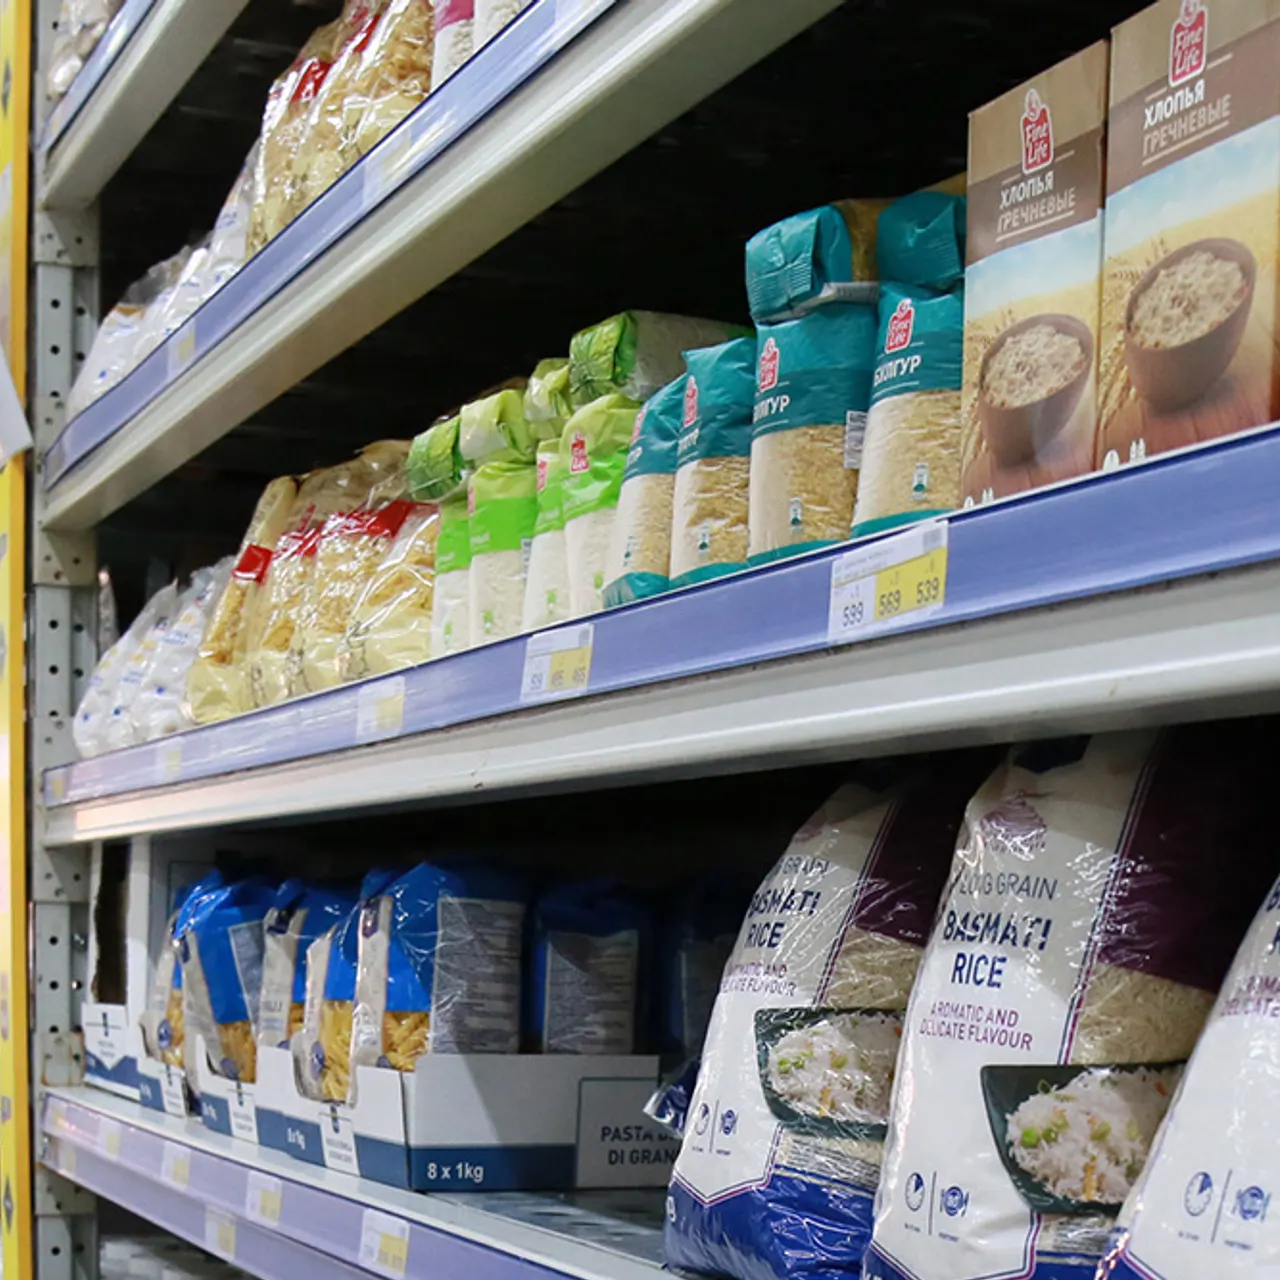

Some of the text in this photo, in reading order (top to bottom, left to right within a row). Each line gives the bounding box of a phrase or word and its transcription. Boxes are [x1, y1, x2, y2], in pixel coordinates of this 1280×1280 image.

[1176, 26, 1203, 51] Fine
[1174, 48, 1202, 76] Life
[1143, 79, 1205, 130] ХЛОПЬЯ
[1024, 121, 1048, 147] Fine
[1142, 94, 1231, 156] ГРЕЧНЕВЫЕ
[1026, 143, 1049, 168] Life
[999, 170, 1055, 210] ХЛОПЬЯ
[996, 185, 1076, 234] ГРЕЧНЕВЫЕ
[996, 872, 1058, 901] GRAIN
[748, 889, 821, 918] ASMATI
[745, 922, 785, 949] RICE
[943, 910, 1052, 951] BASMATI
[951, 952, 1008, 989] RICE
[987, 1010, 1020, 1028] AND
[968, 1024, 1034, 1051] FLAVOUR
[608, 1150, 624, 1165] DI
[628, 1149, 681, 1166] GRAN
[426, 1163, 484, 1182] 8 x 1kg
